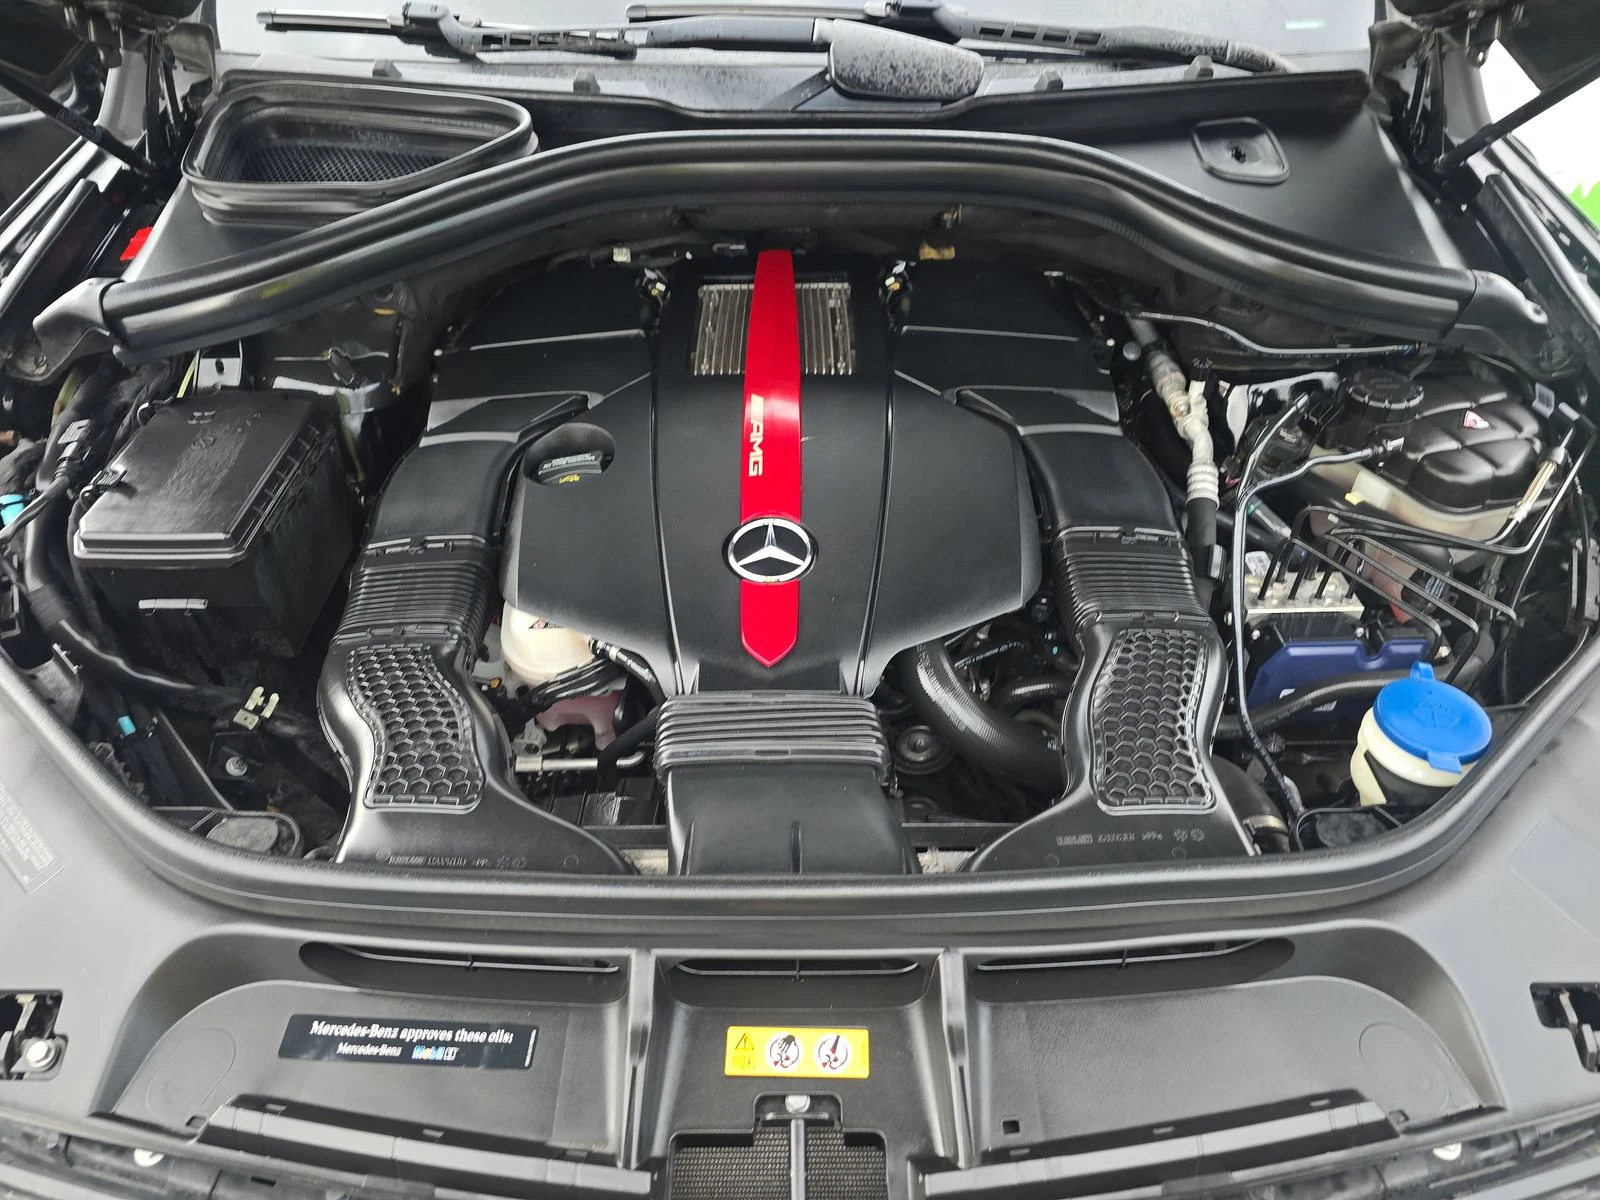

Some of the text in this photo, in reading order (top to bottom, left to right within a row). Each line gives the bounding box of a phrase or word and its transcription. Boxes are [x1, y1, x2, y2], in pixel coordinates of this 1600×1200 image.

[749, 419, 764, 477] AMG
[309, 1020, 399, 1039] Mercedes-Benz
[399, 1027, 453, 1043] approves
[454, 1028, 488, 1043] these
[336, 1042, 402, 1057] Mercedes-Benz
[411, 1045, 445, 1060] Mobil
